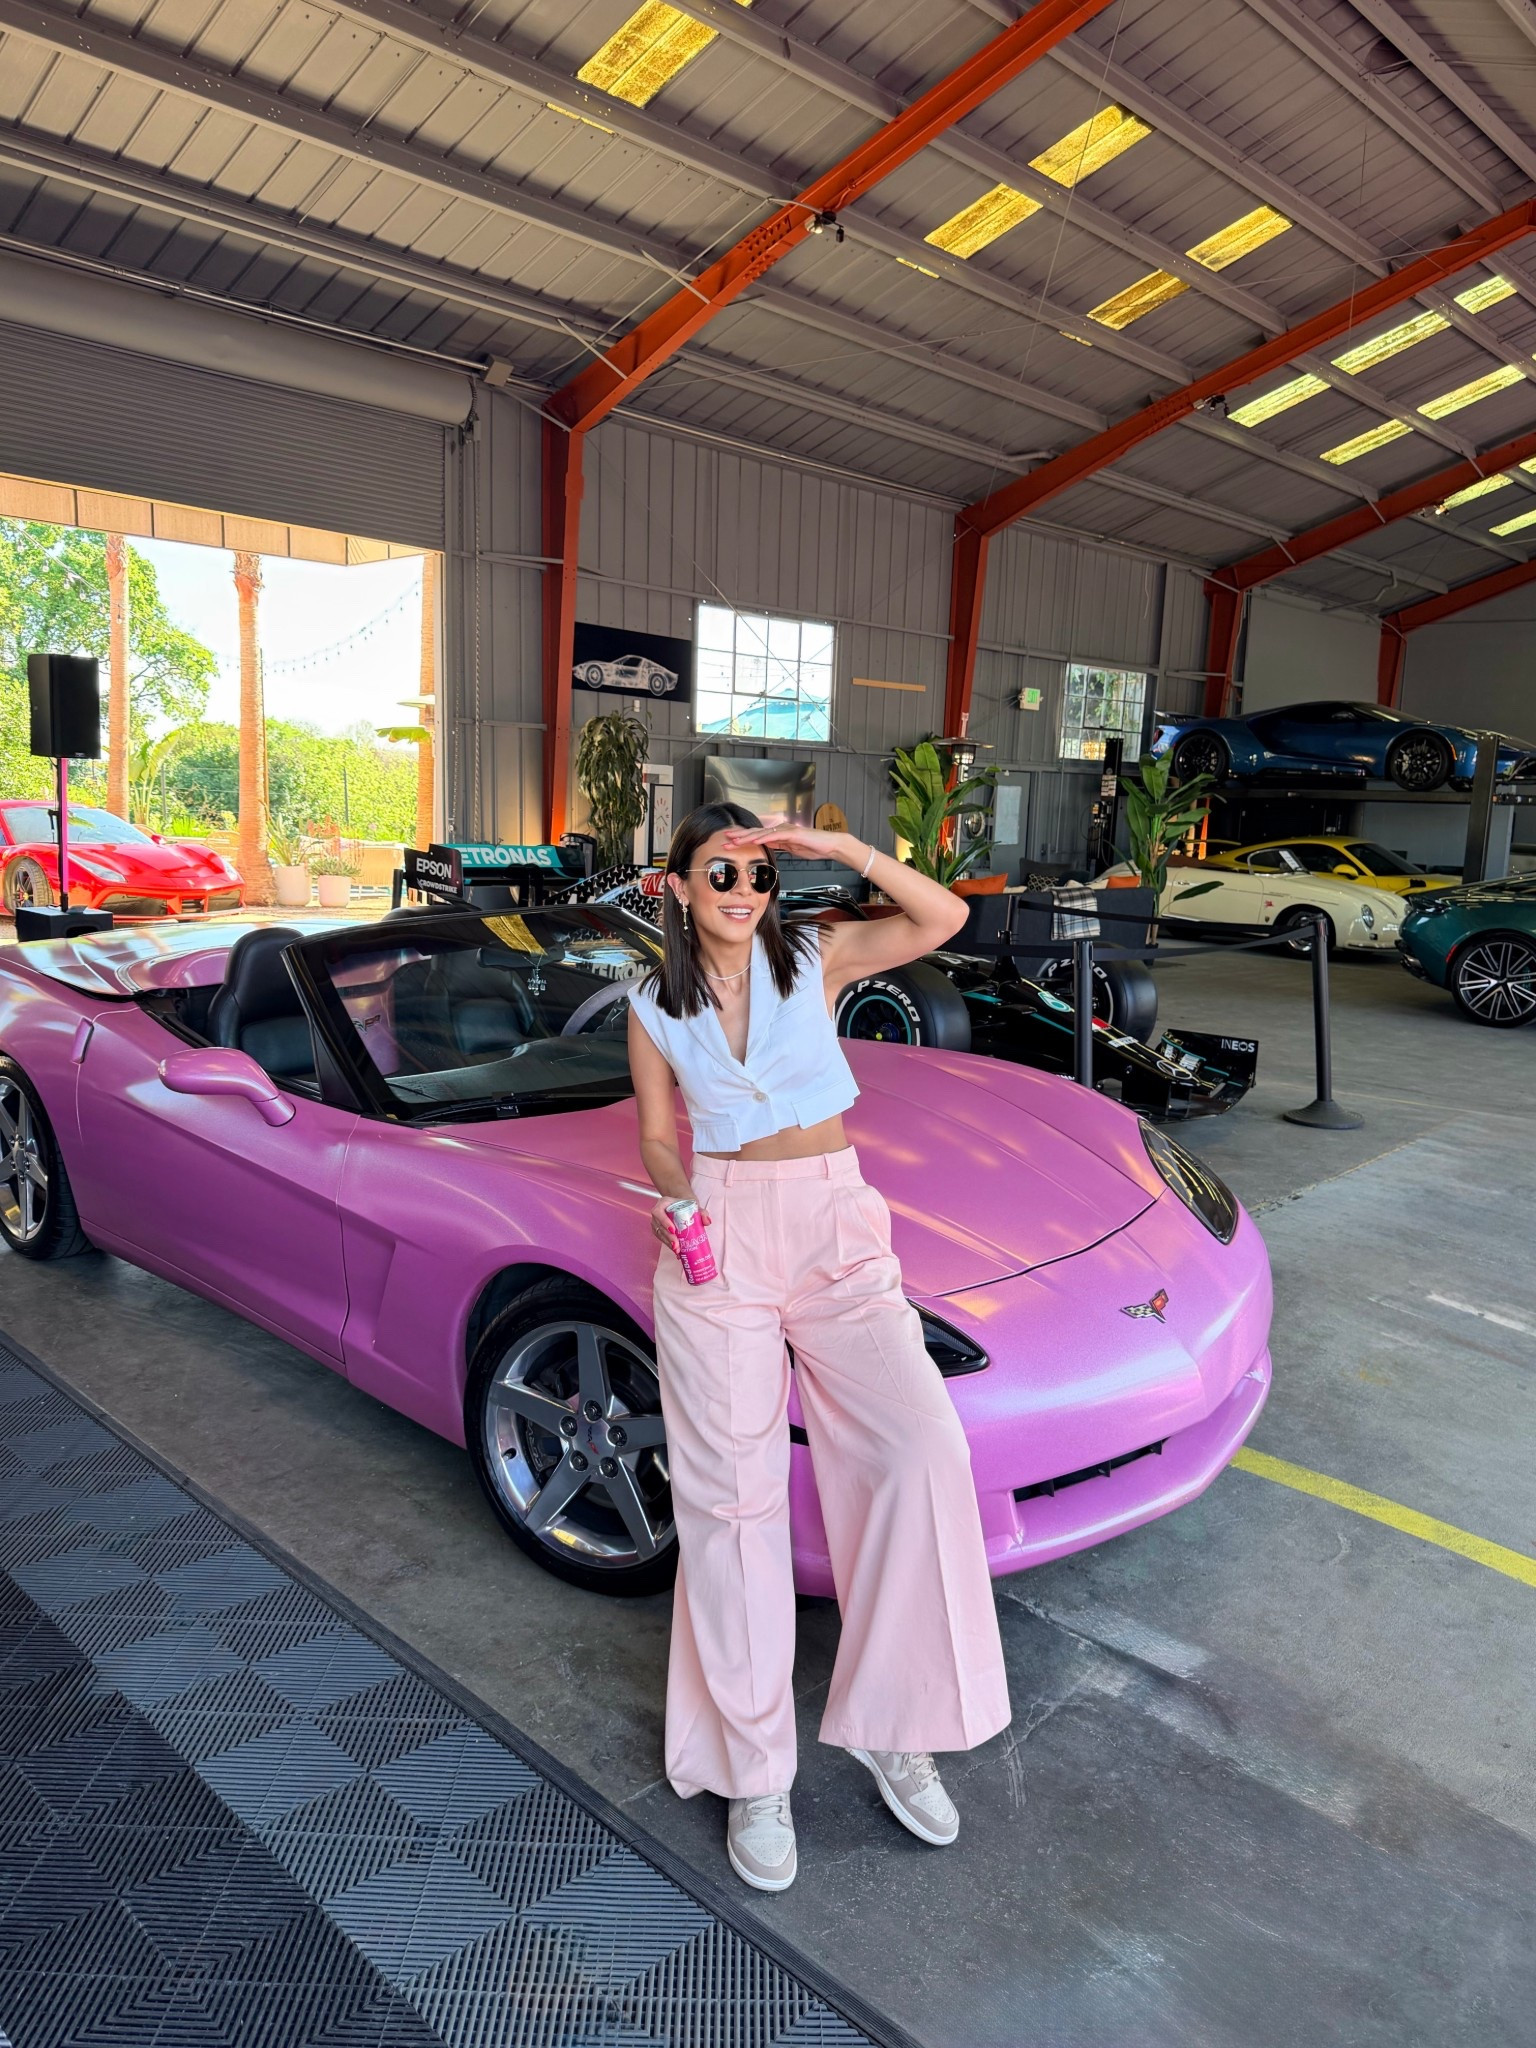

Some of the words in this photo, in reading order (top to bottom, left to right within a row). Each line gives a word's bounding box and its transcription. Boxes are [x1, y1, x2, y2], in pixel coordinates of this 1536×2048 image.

[456, 847, 551, 866] ETRONAS
[416, 857, 452, 878] EPSON
[418, 879, 458, 894] CROWDSTRIKE
[592, 961, 652, 980] PETRON
[1048, 963, 1058, 977] P
[1060, 959, 1107, 979] ZO
[857, 980, 870, 993] P
[873, 980, 921, 1022] ZERO
[1221, 1039, 1255, 1053] INEOS
[681, 1254, 690, 1268] Bull
[685, 1268, 695, 1283] Red
